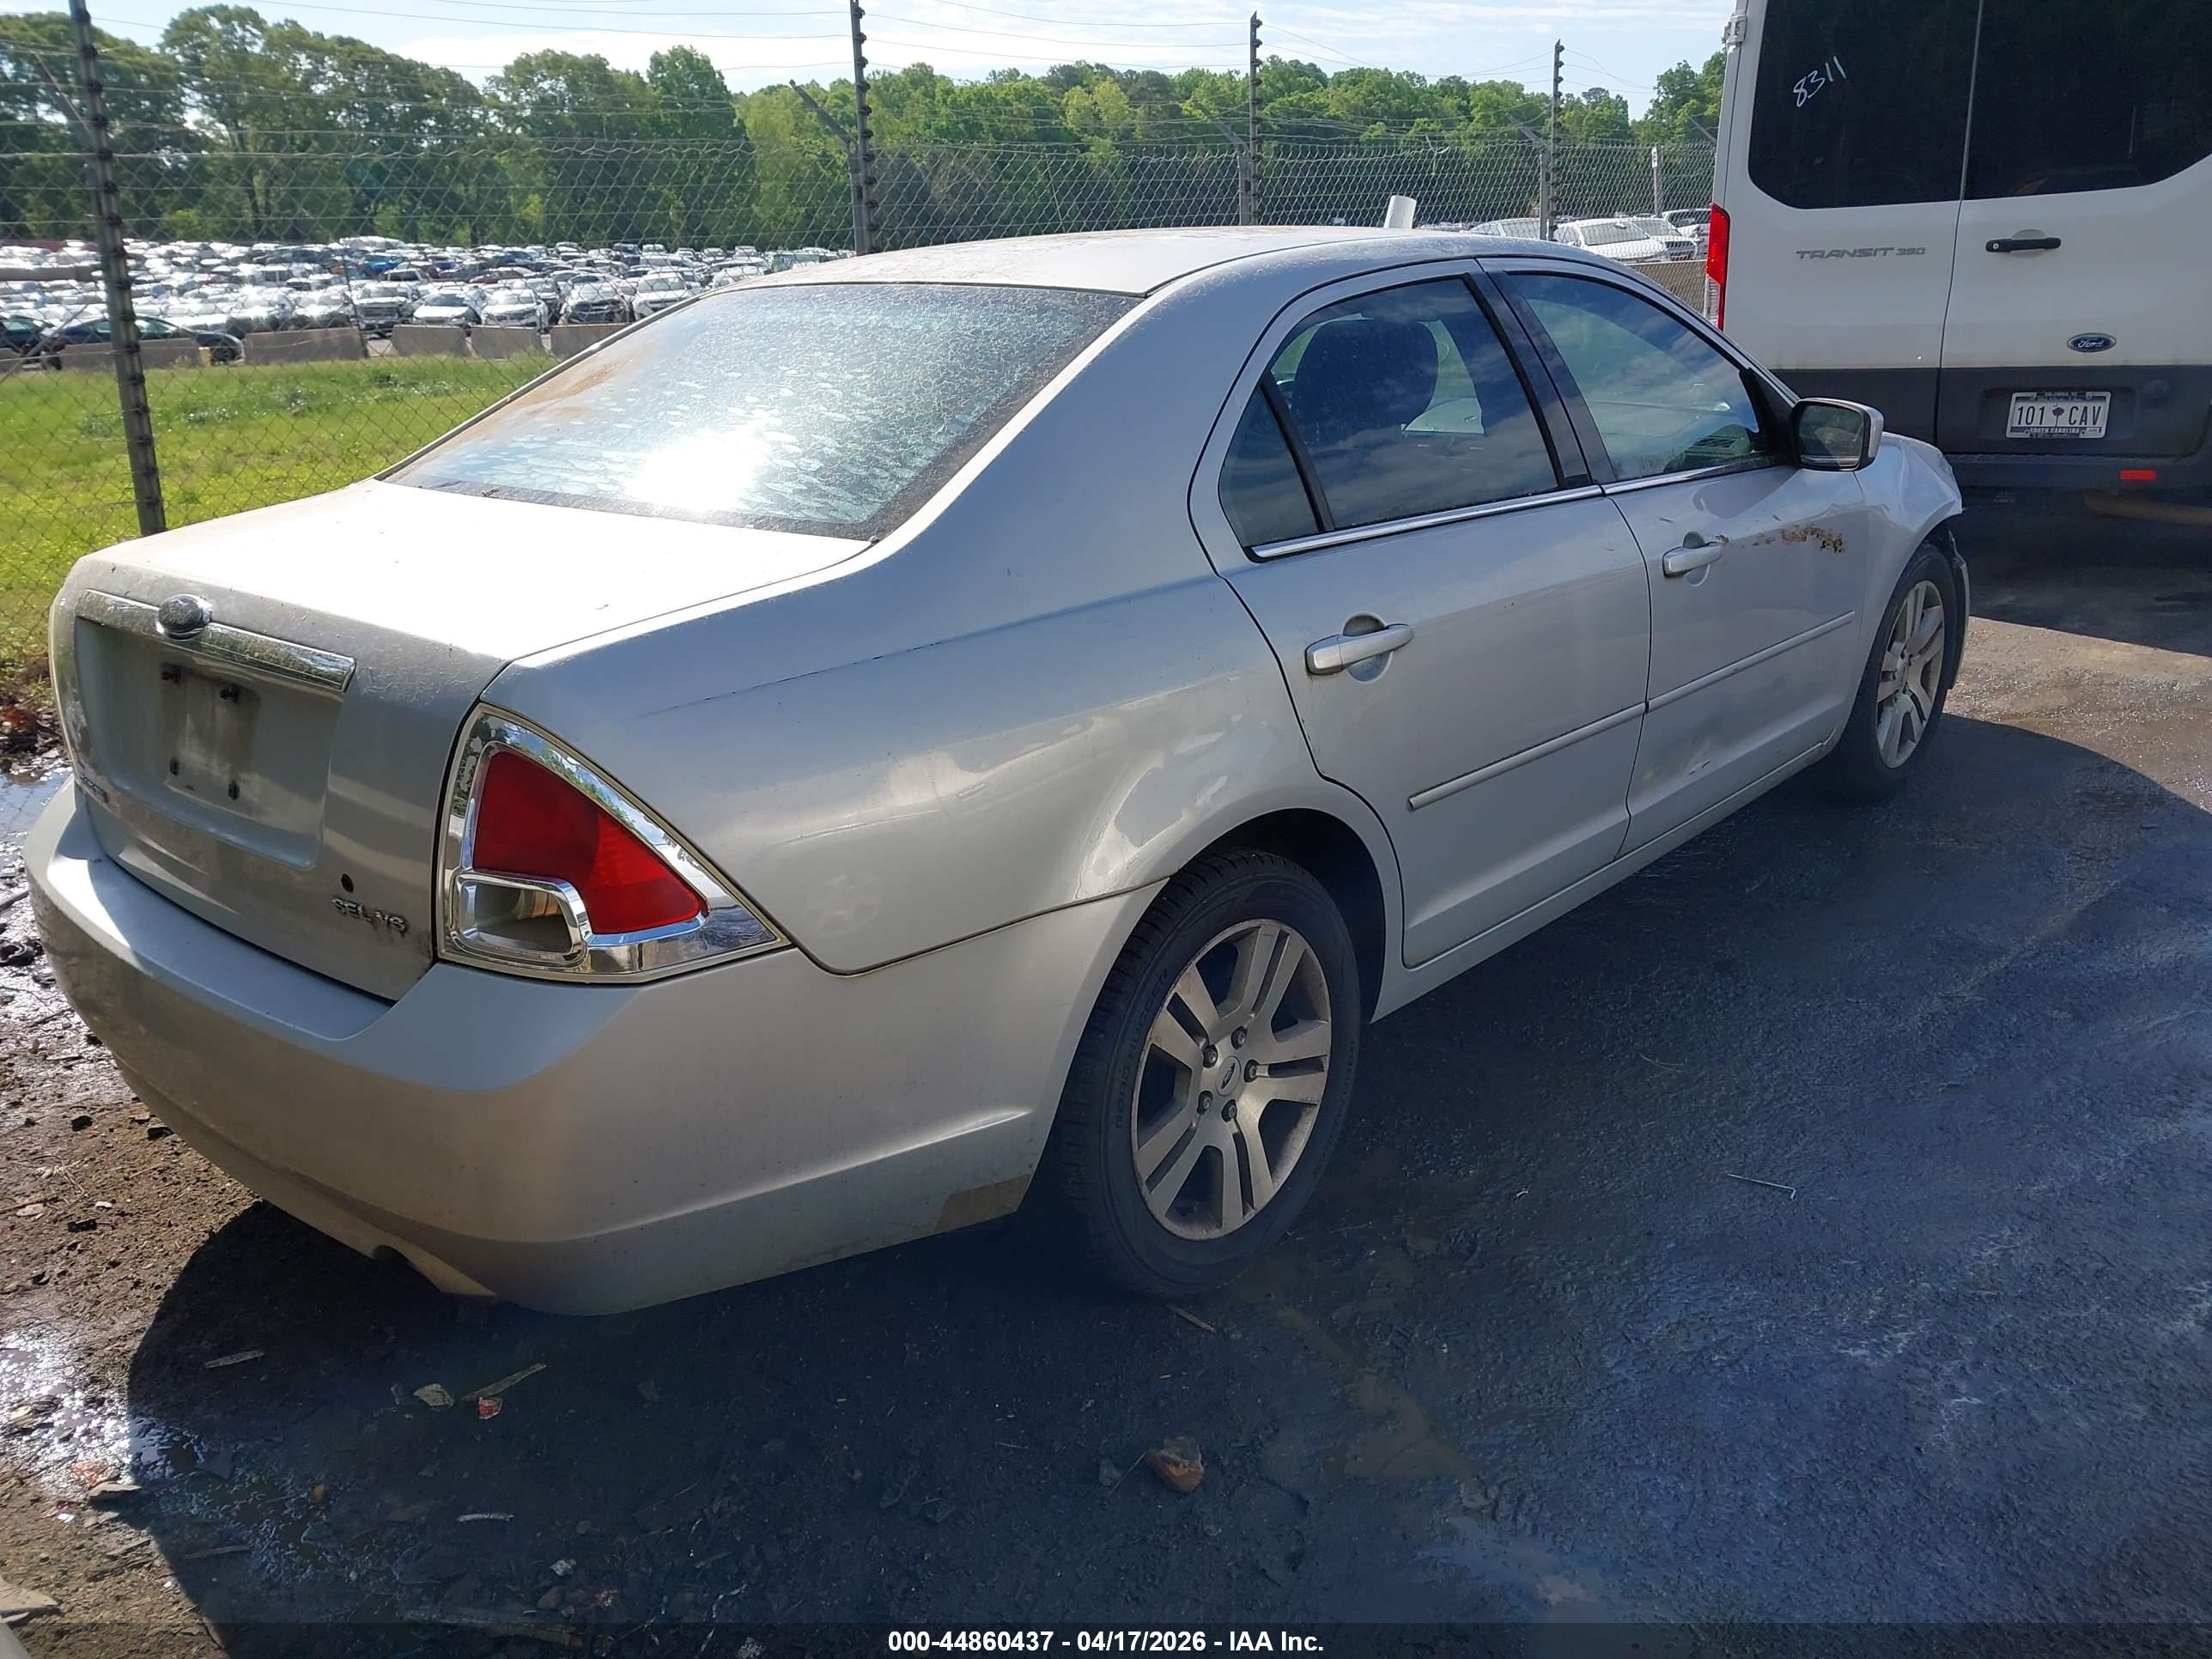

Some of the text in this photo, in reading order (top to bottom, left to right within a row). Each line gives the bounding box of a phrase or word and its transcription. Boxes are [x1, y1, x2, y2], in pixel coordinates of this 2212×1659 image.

[1793, 56, 1846, 107] 8311
[1796, 246, 1926, 259] TRANSIT 350
[2017, 405, 2101, 426] 101 CAV
